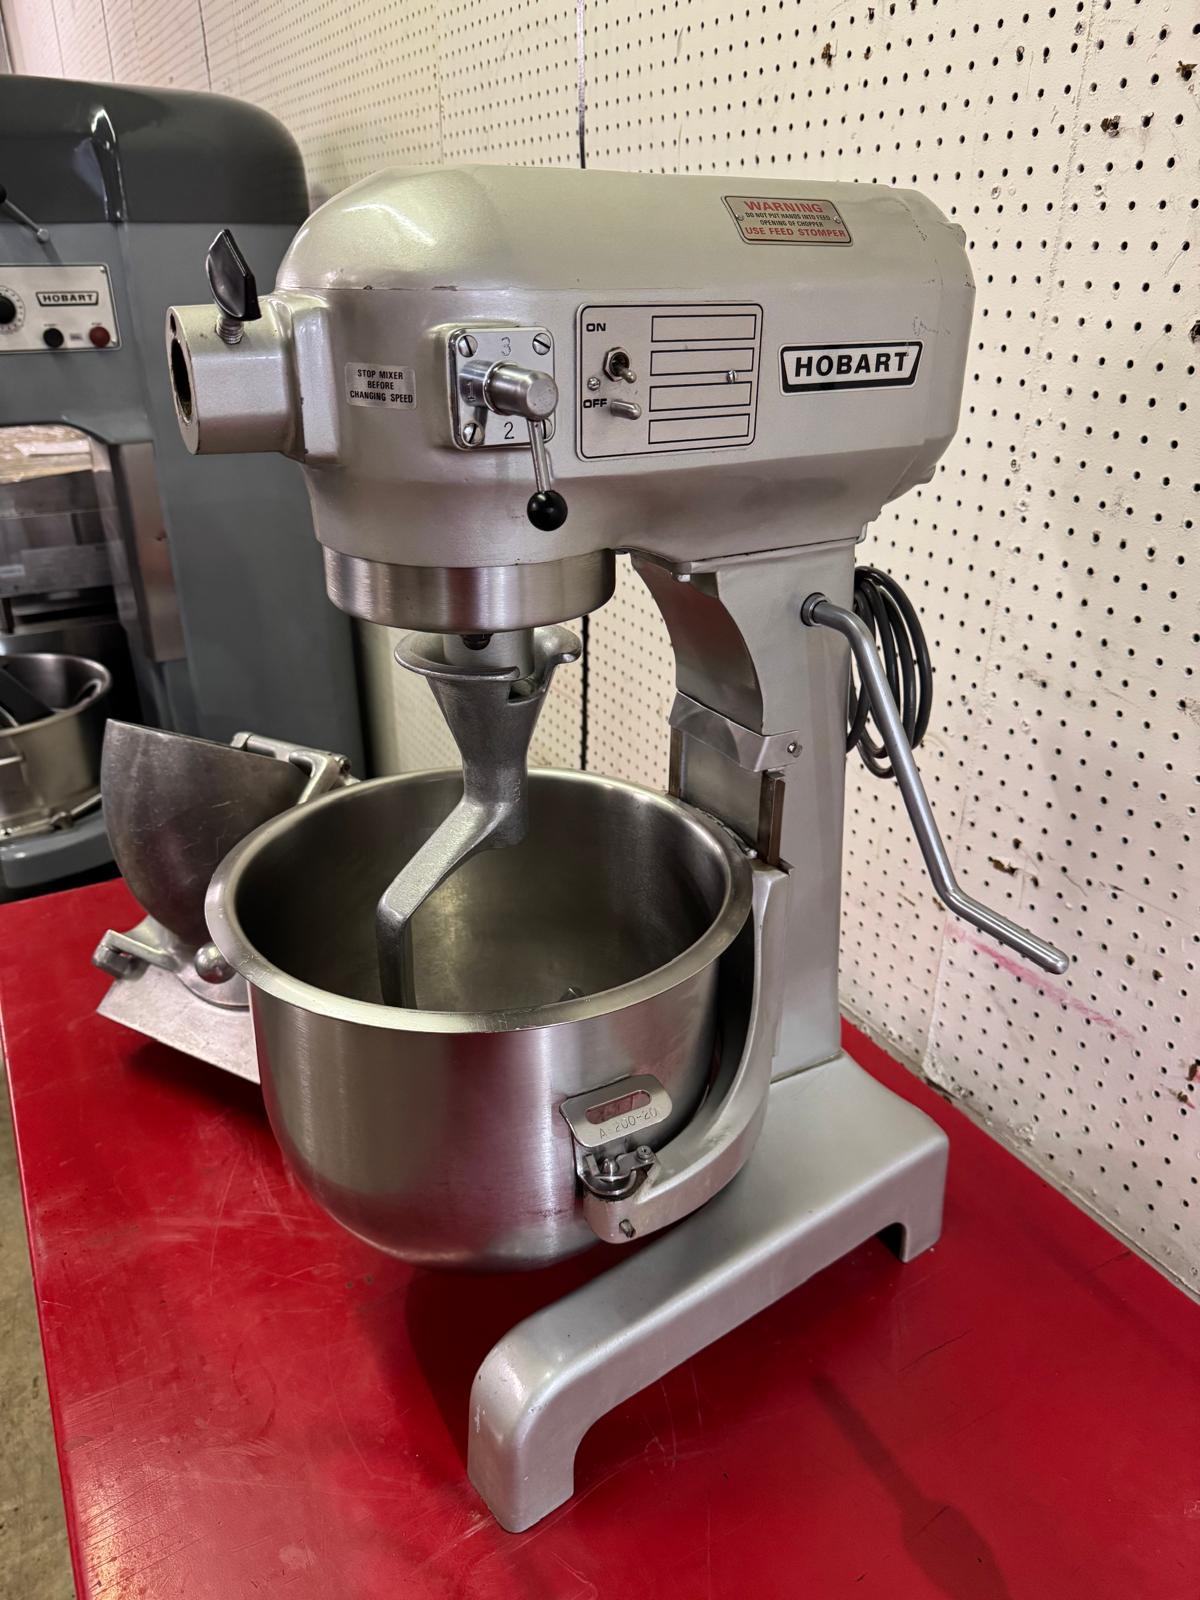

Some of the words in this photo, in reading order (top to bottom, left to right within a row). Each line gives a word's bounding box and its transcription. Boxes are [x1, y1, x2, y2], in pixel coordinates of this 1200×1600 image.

[744, 201, 823, 213] WARNING
[745, 227, 766, 235] USE
[769, 228, 794, 236] FEED
[798, 229, 846, 237] STOMPER
[43, 294, 93, 302] HOBART
[586, 322, 606, 332] ON
[501, 336, 512, 357] 3
[795, 352, 909, 377] HOBART
[357, 369, 376, 378] STOP
[379, 371, 404, 380] MIXER
[367, 380, 394, 390] BEFORE
[350, 390, 386, 402] CHANGING
[390, 393, 413, 403] SPEED
[583, 399, 607, 408] OFF
[503, 422, 515, 440] 2
